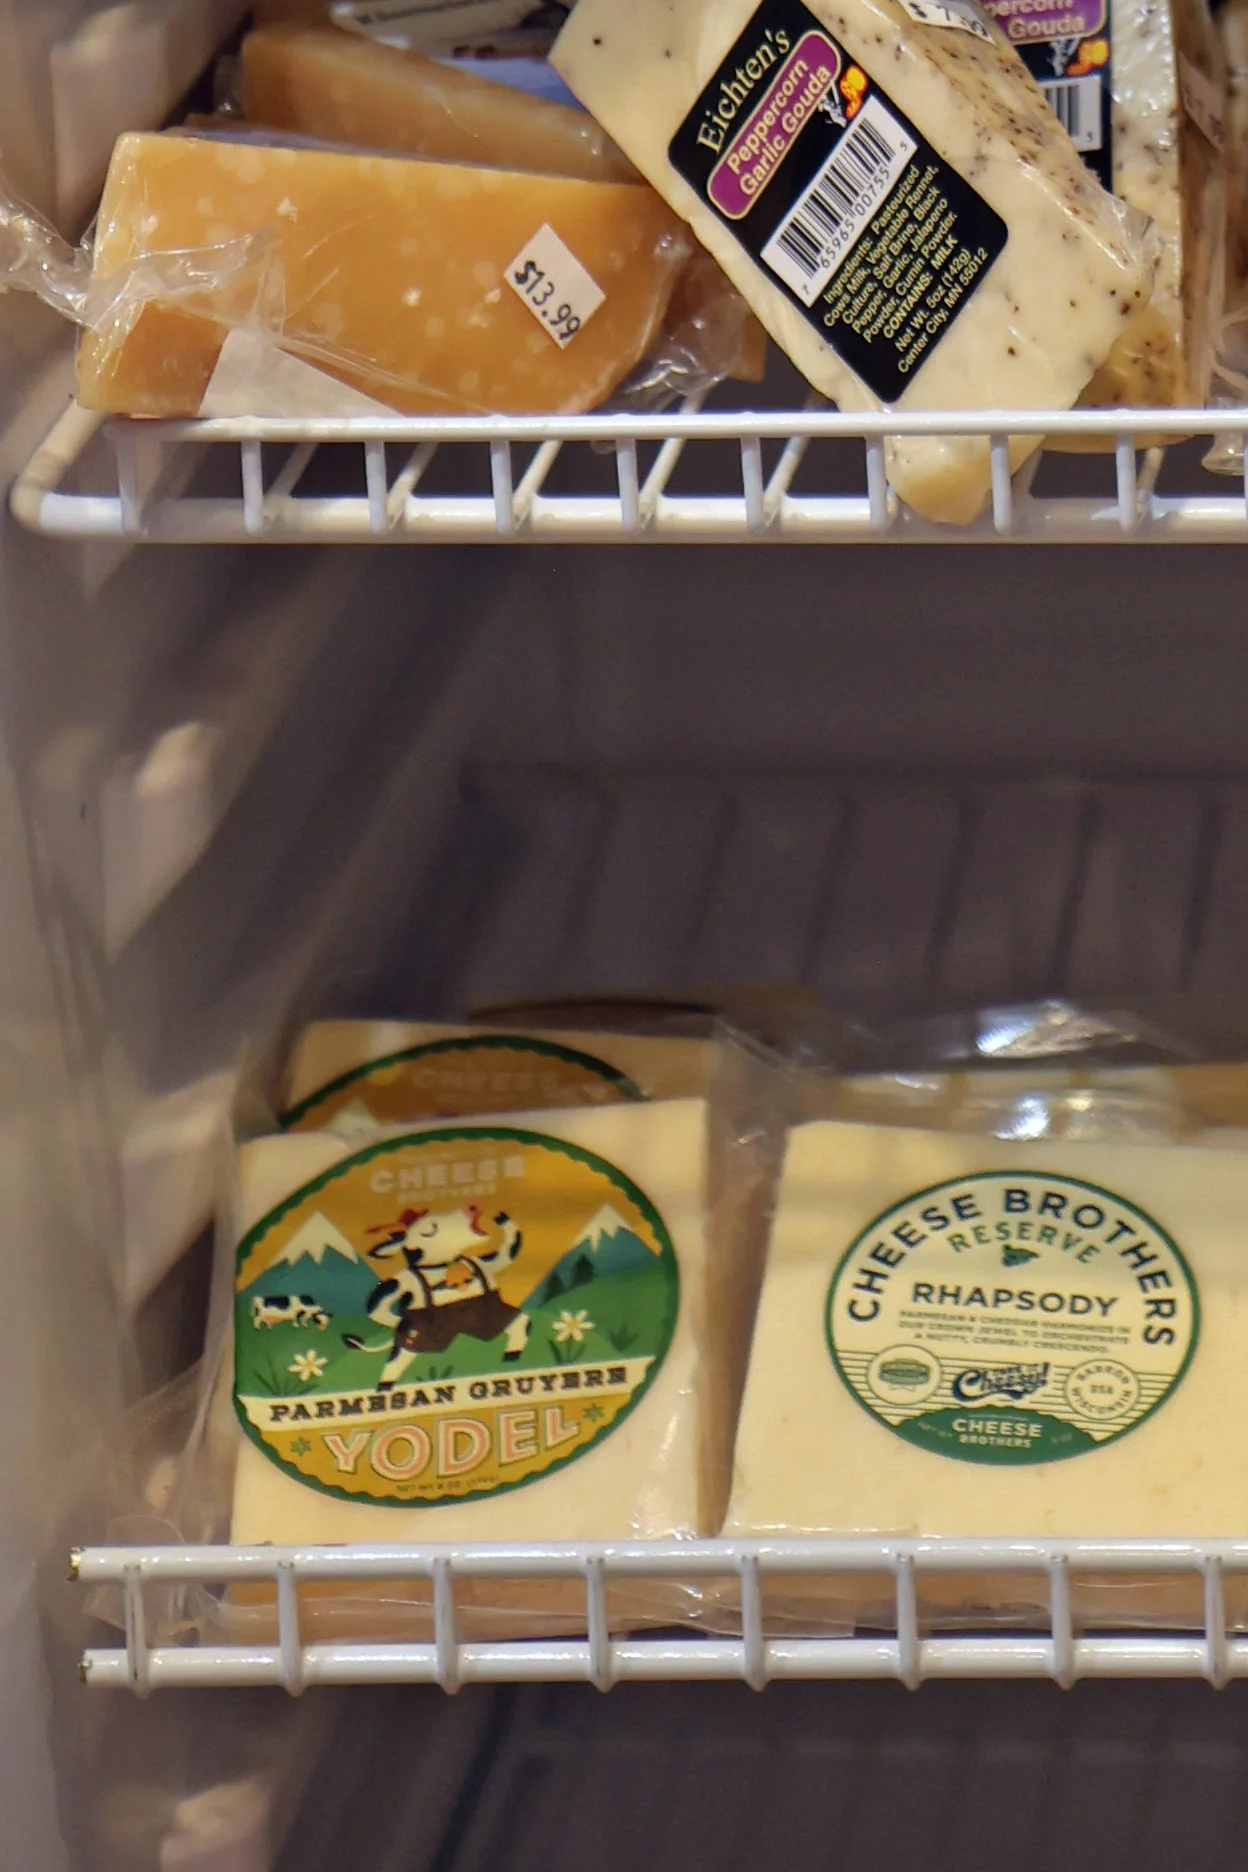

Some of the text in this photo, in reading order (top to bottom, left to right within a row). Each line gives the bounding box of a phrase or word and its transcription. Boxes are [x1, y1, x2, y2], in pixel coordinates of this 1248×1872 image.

[1008, 15, 1086, 39] Gouda
[697, 29, 790, 154] Eichten's
[727, 59, 809, 175] Peppercorn
[739, 65, 832, 196] Garlic Gouda
[819, 166, 890, 269] 65965 00755
[511, 258, 581, 342] $13.99
[882, 234, 959, 339] CONTAINS: MILK
[894, 247, 972, 352] Net Wt. 5oz (142g)
[370, 1156, 526, 1194] CHEESE
[848, 1187, 1178, 1348] CHEESE BROTHERS
[948, 1220, 1102, 1266] RESERVE
[911, 1282, 1119, 1318] RHAPSODY
[269, 1366, 628, 1424] PARMESAN GRUYERE
[952, 1418, 1043, 1438] CHEESE
[321, 1406, 582, 1481] YODEL
[959, 1435, 1032, 1449] BROTHERS
